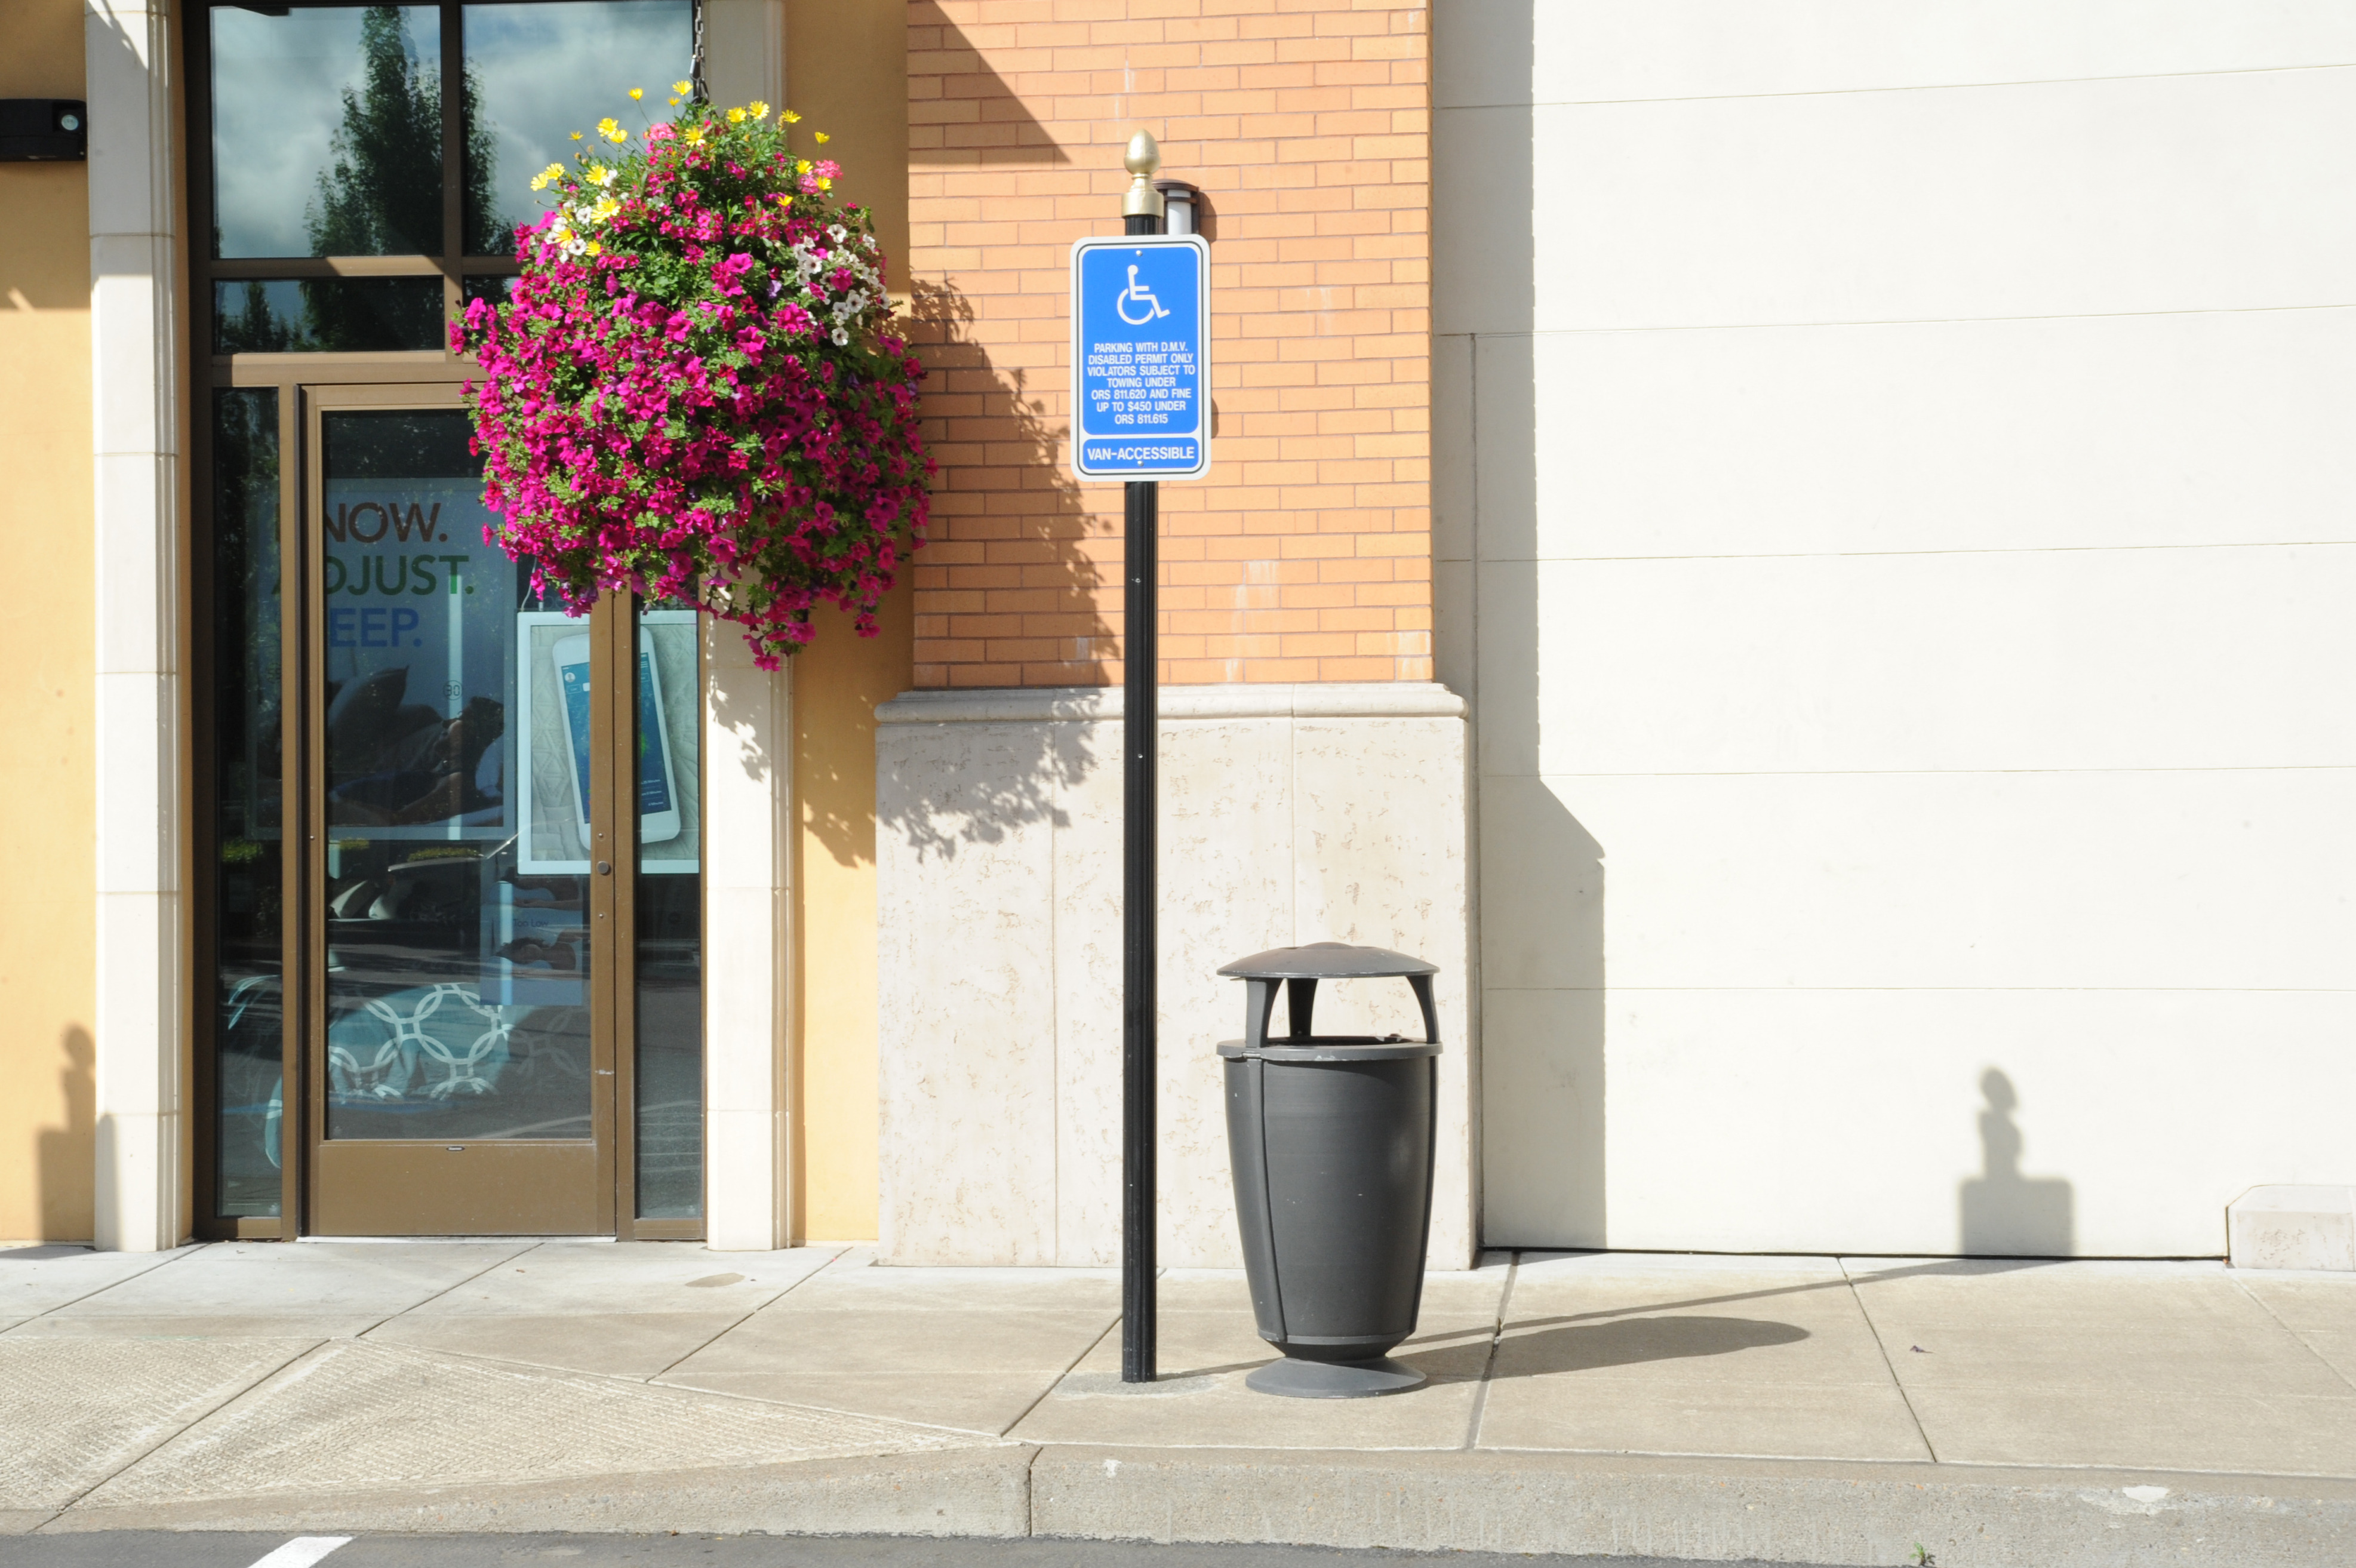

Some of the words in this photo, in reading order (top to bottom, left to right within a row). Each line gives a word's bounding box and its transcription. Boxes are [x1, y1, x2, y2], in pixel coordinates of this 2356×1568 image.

[1094, 343, 1133, 353] PARKING
[1136, 342, 1158, 352] WITH
[1161, 342, 1188, 352] D.M.V.
[1088, 355, 1131, 365] DISABLED
[1135, 354, 1168, 364] PERMIT
[1171, 353, 1193, 362] ONLY
[1087, 366, 1136, 376] VIOLATORS
[1140, 365, 1180, 376] SUBJECT
[1183, 365, 1195, 374] TO
[1106, 377, 1142, 388] TOWING
[1145, 377, 1176, 387] UNDER
[1091, 390, 1111, 399] ORS
[1114, 389, 1146, 399] 811.620
[1149, 389, 1168, 398] AND
[1171, 389, 1191, 398] FINE
[1097, 402, 1109, 412] UP
[1111, 402, 1124, 411] TO
[1127, 401, 1151, 412] $450
[1155, 401, 1186, 411] UNDER
[1115, 414, 1134, 424] ORS
[1137, 414, 1168, 423] 811.615
[1087, 447, 1195, 460] VAN-ACCESSIBLE
[531, 918, 549, 927] Low
